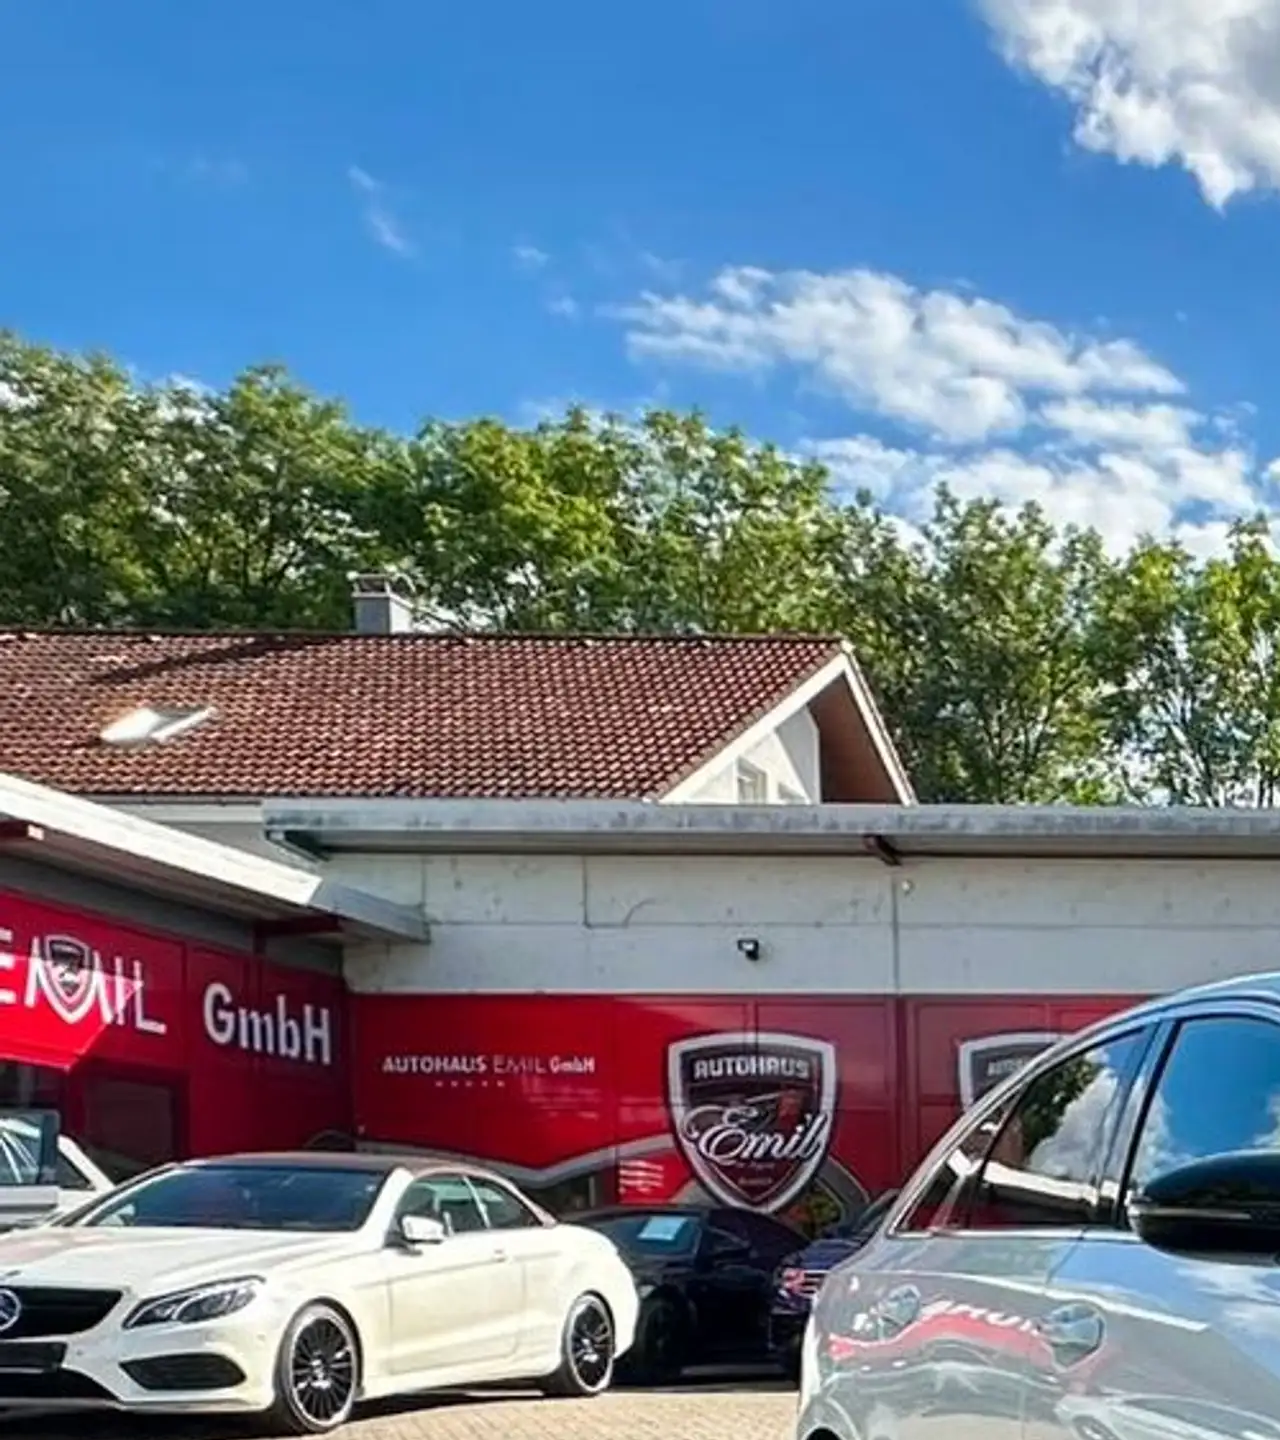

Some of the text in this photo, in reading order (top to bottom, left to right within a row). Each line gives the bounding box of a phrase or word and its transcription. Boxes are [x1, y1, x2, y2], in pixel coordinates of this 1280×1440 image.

[203, 982, 331, 1065] GmbH
[382, 1055, 596, 1074] AUTOHAUS EMIL GmbH
[693, 1056, 810, 1080] AUTOHAUS
[682, 1104, 830, 1166] Emil
